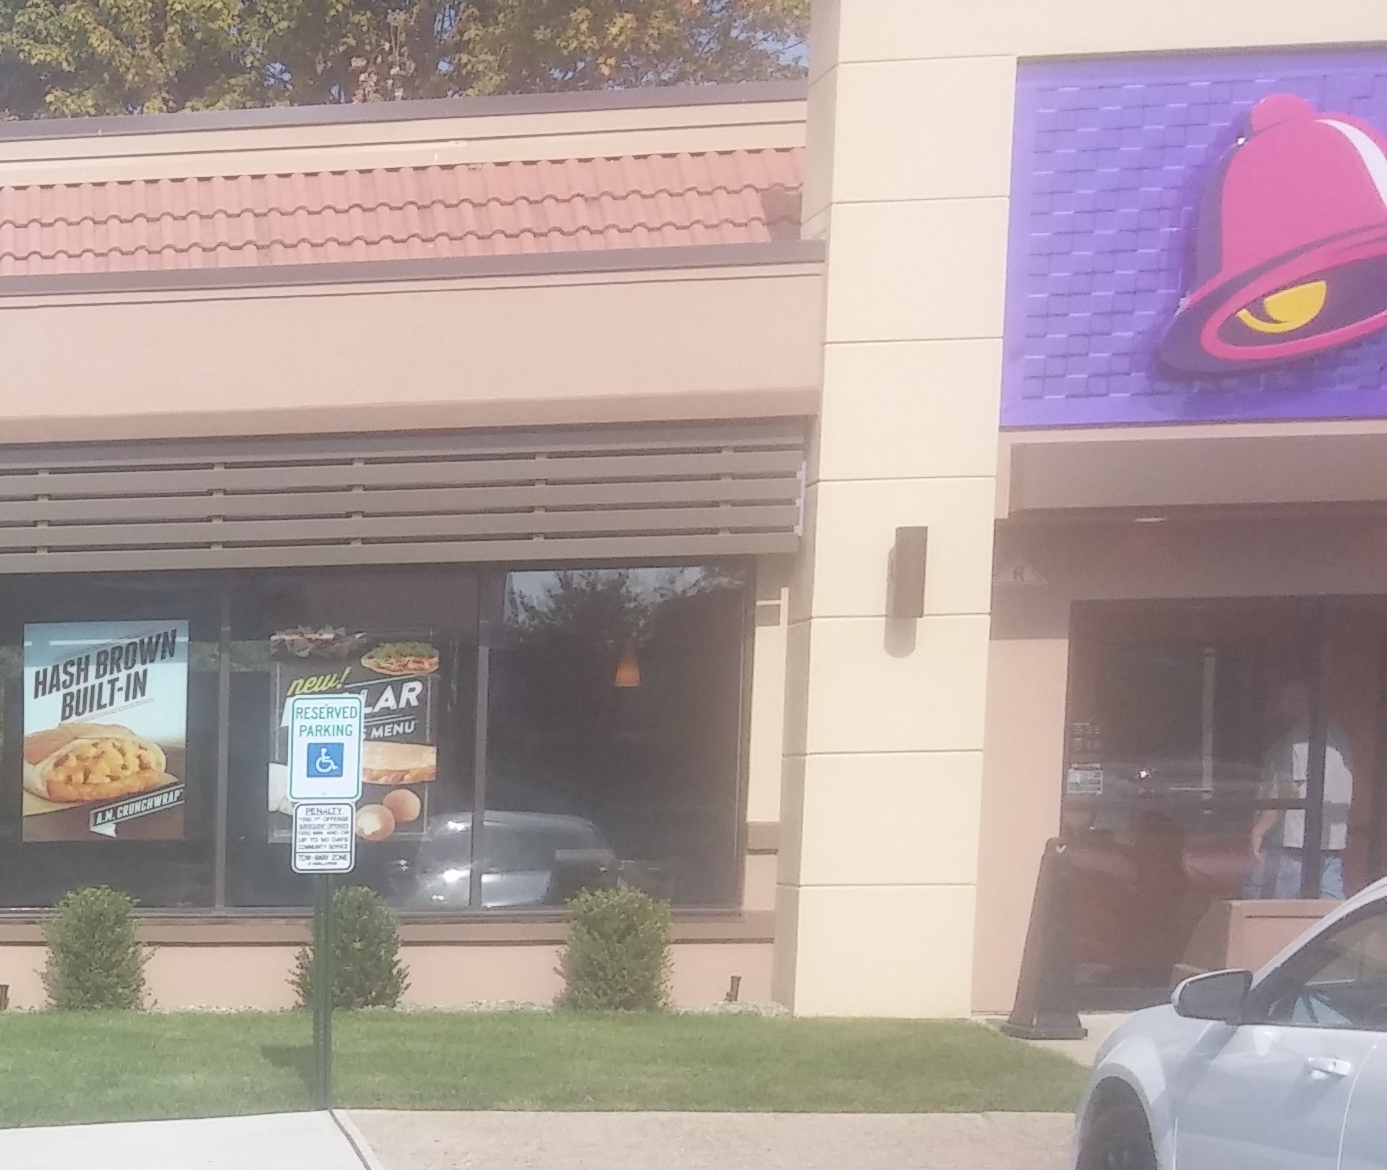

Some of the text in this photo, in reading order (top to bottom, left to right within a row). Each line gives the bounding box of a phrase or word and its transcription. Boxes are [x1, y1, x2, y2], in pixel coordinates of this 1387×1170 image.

[34, 629, 177, 700] HASH BROWN
[61, 668, 148, 722] BUILT-IN
[287, 666, 353, 696] new!
[295, 706, 358, 719] RESERVED
[299, 723, 353, 738] PARKING
[370, 720, 417, 739] MENU
[96, 789, 182, 824] A.M. CRUNCHWRAP
